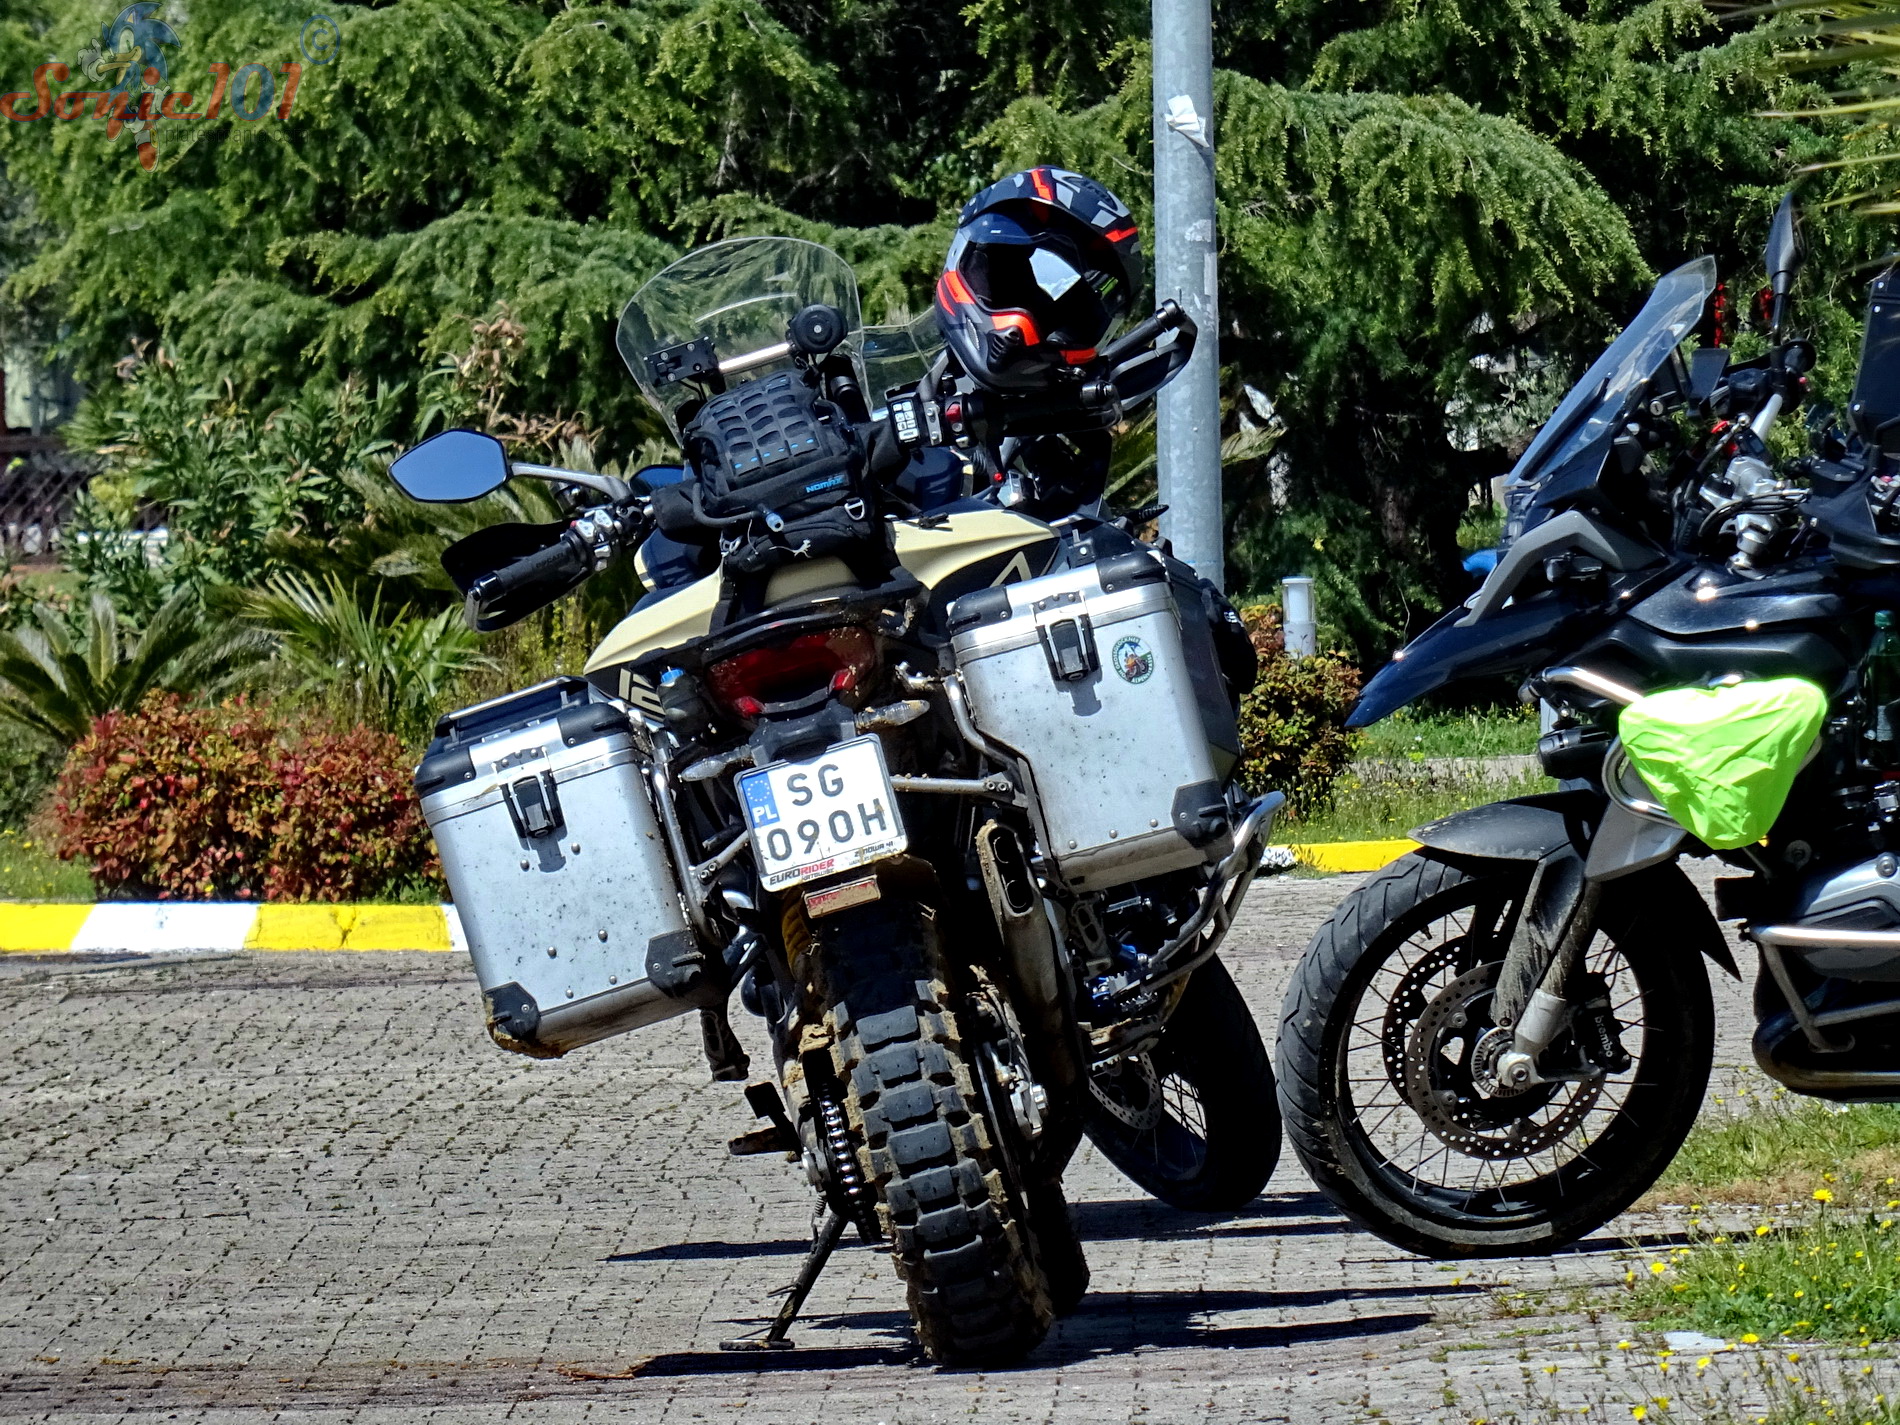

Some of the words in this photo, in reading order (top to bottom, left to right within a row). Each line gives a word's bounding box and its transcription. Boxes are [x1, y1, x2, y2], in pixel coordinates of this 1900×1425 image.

[786, 763, 844, 807] SG
[752, 805, 778, 824] PL
[766, 797, 888, 862] 090H
[769, 858, 835, 886] EURORIDER
[1594, 1014, 1613, 1058] brembo
